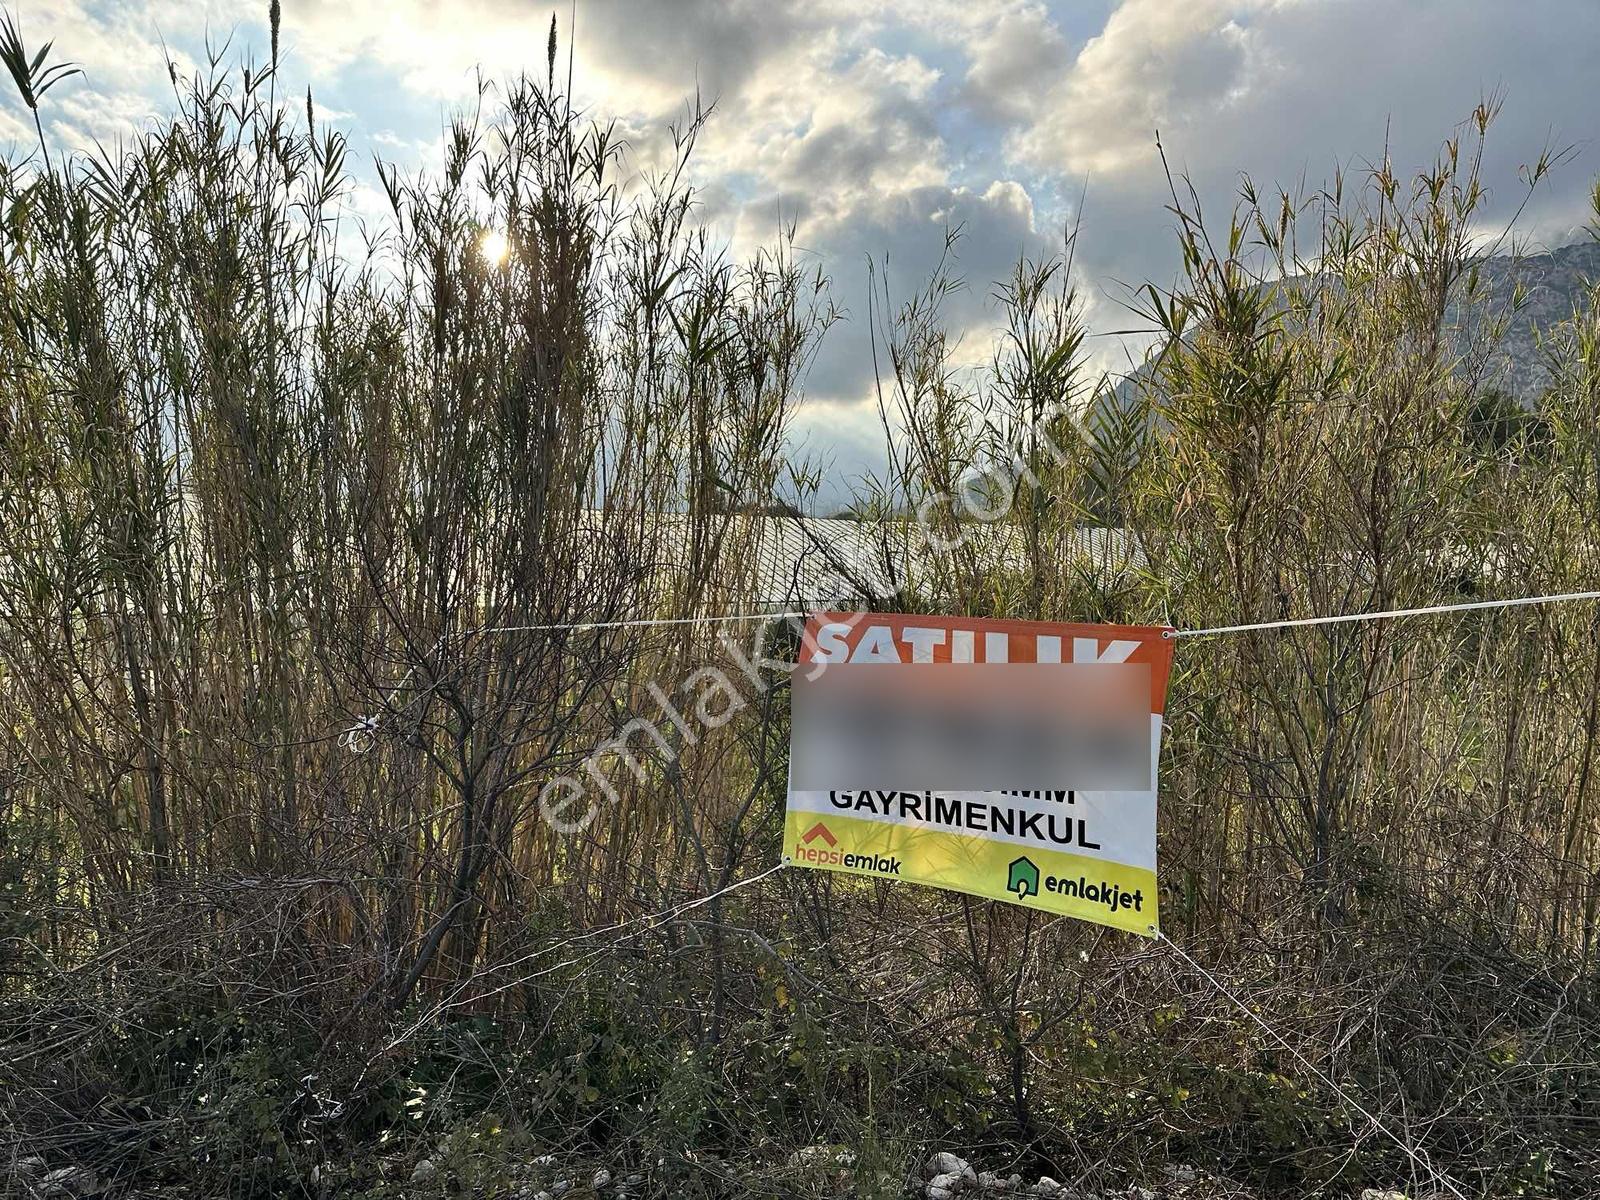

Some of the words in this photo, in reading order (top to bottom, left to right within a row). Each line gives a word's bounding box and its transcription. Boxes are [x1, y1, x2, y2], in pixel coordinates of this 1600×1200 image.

[829, 791, 1101, 850] GAYRİMENKUL
[795, 843, 902, 876] hepsiemlak
[1045, 873, 1143, 912] emlakjet
